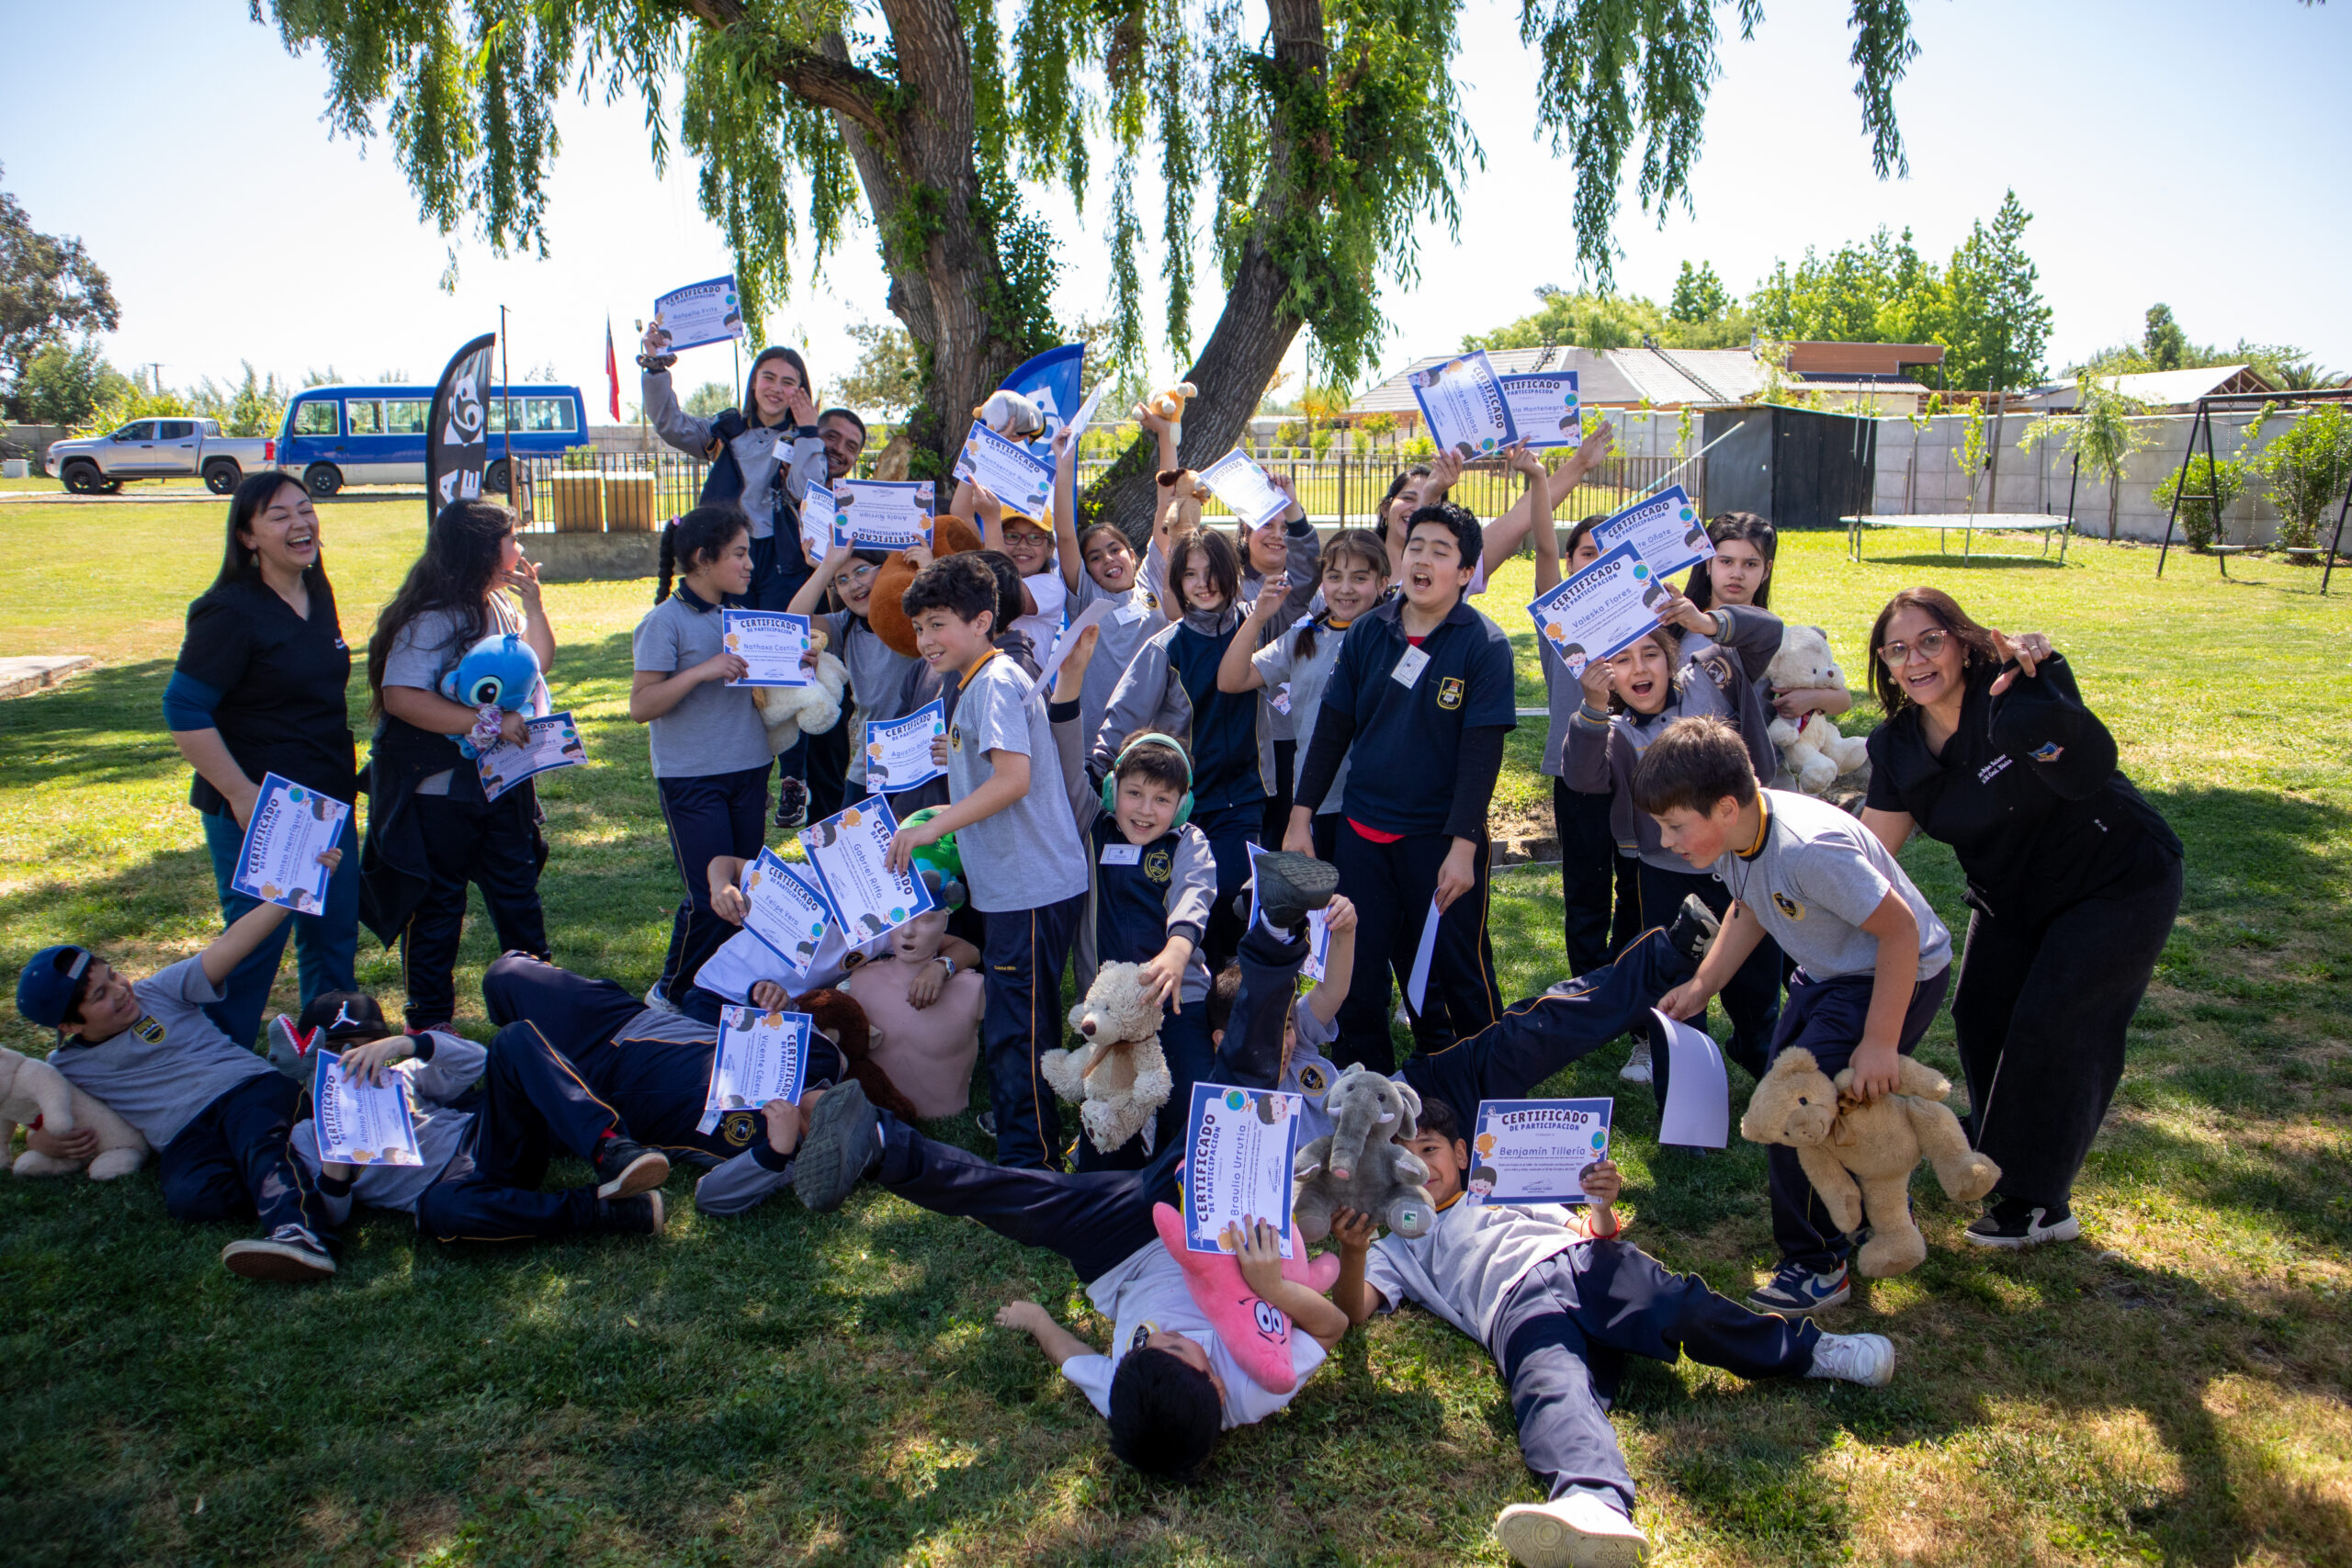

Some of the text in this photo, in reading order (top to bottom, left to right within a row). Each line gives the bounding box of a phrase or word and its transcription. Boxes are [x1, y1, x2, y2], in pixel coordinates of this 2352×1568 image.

[666, 286, 721, 305] CERTIFICADO
[1473, 367, 1504, 429] CERTIFICADO
[1475, 379, 1494, 424] PARTICIPACION
[1503, 380, 1560, 391] RTIFICADO
[1462, 400, 1478, 434] Hinojosa
[1523, 404, 1564, 412] Montenegro
[985, 437, 1040, 473] CERTIFICADO
[1608, 502, 1670, 538] CERTIFICADO
[1623, 513, 1666, 536] PARTICIPACION
[852, 531, 916, 544] CERTIFICADO
[1552, 561, 1622, 611] CERTIFICADO
[1562, 573, 1618, 612] DE PARTICIPACION
[741, 618, 797, 632] CERTIFICADO
[1573, 588, 1632, 628] Valeska Flores
[886, 714, 932, 738] CERTIFICADO
[250, 798, 279, 874] CERTIFICADO
[259, 809, 282, 869] DE PARTICIPACION
[870, 831, 877, 840] DE
[276, 853, 288, 884] Alonso
[854, 843, 874, 878] Gabriel
[765, 895, 784, 914] Felipe
[769, 866, 819, 911] CERTIFICADO
[775, 882, 810, 912] PARTICIPACION
[757, 1035, 769, 1067] Vicente
[775, 1041, 787, 1093] DE PARTICIPACION
[779, 1033, 797, 1097] CERTIFICADO
[323, 1075, 342, 1145] CERTIFICADO
[1501, 1110, 1589, 1125] CERTIFICADO
[1510, 1122, 1580, 1132] DE PARTICIPACION
[358, 1115, 368, 1144] Alfonso
[1196, 1114, 1216, 1223] CERTIFICADO
[1499, 1145, 1586, 1158] Benjamín Tillería
[1206, 1126, 1222, 1213] DE PARTICIPACION
[1230, 1125, 1247, 1217] Braulio Urrutia
